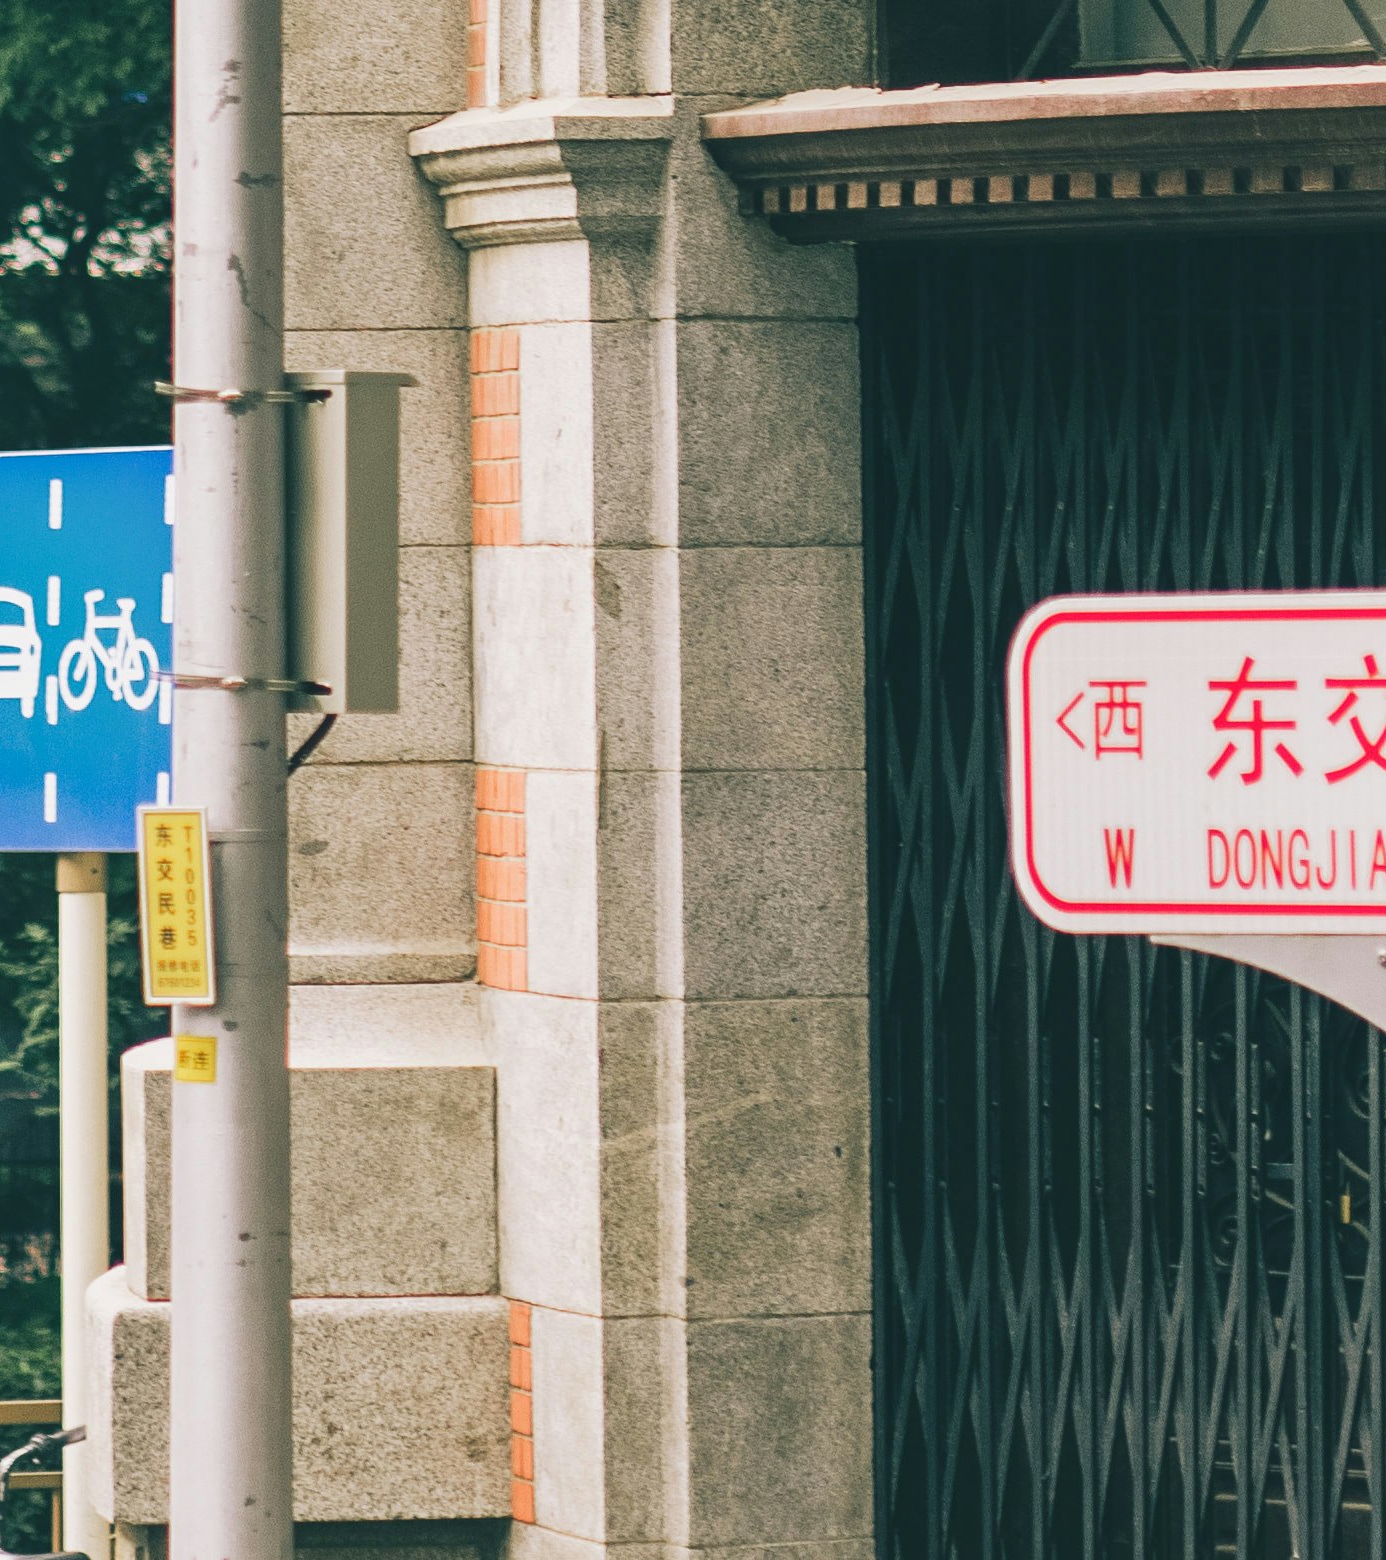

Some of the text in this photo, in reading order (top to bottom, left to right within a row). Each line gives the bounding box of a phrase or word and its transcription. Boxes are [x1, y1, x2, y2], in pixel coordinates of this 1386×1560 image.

[1088, 680, 1147, 760] 西
[155, 823, 177, 951] 东交民巷
[181, 825, 199, 947] T10035
[1103, 829, 1135, 889] W
